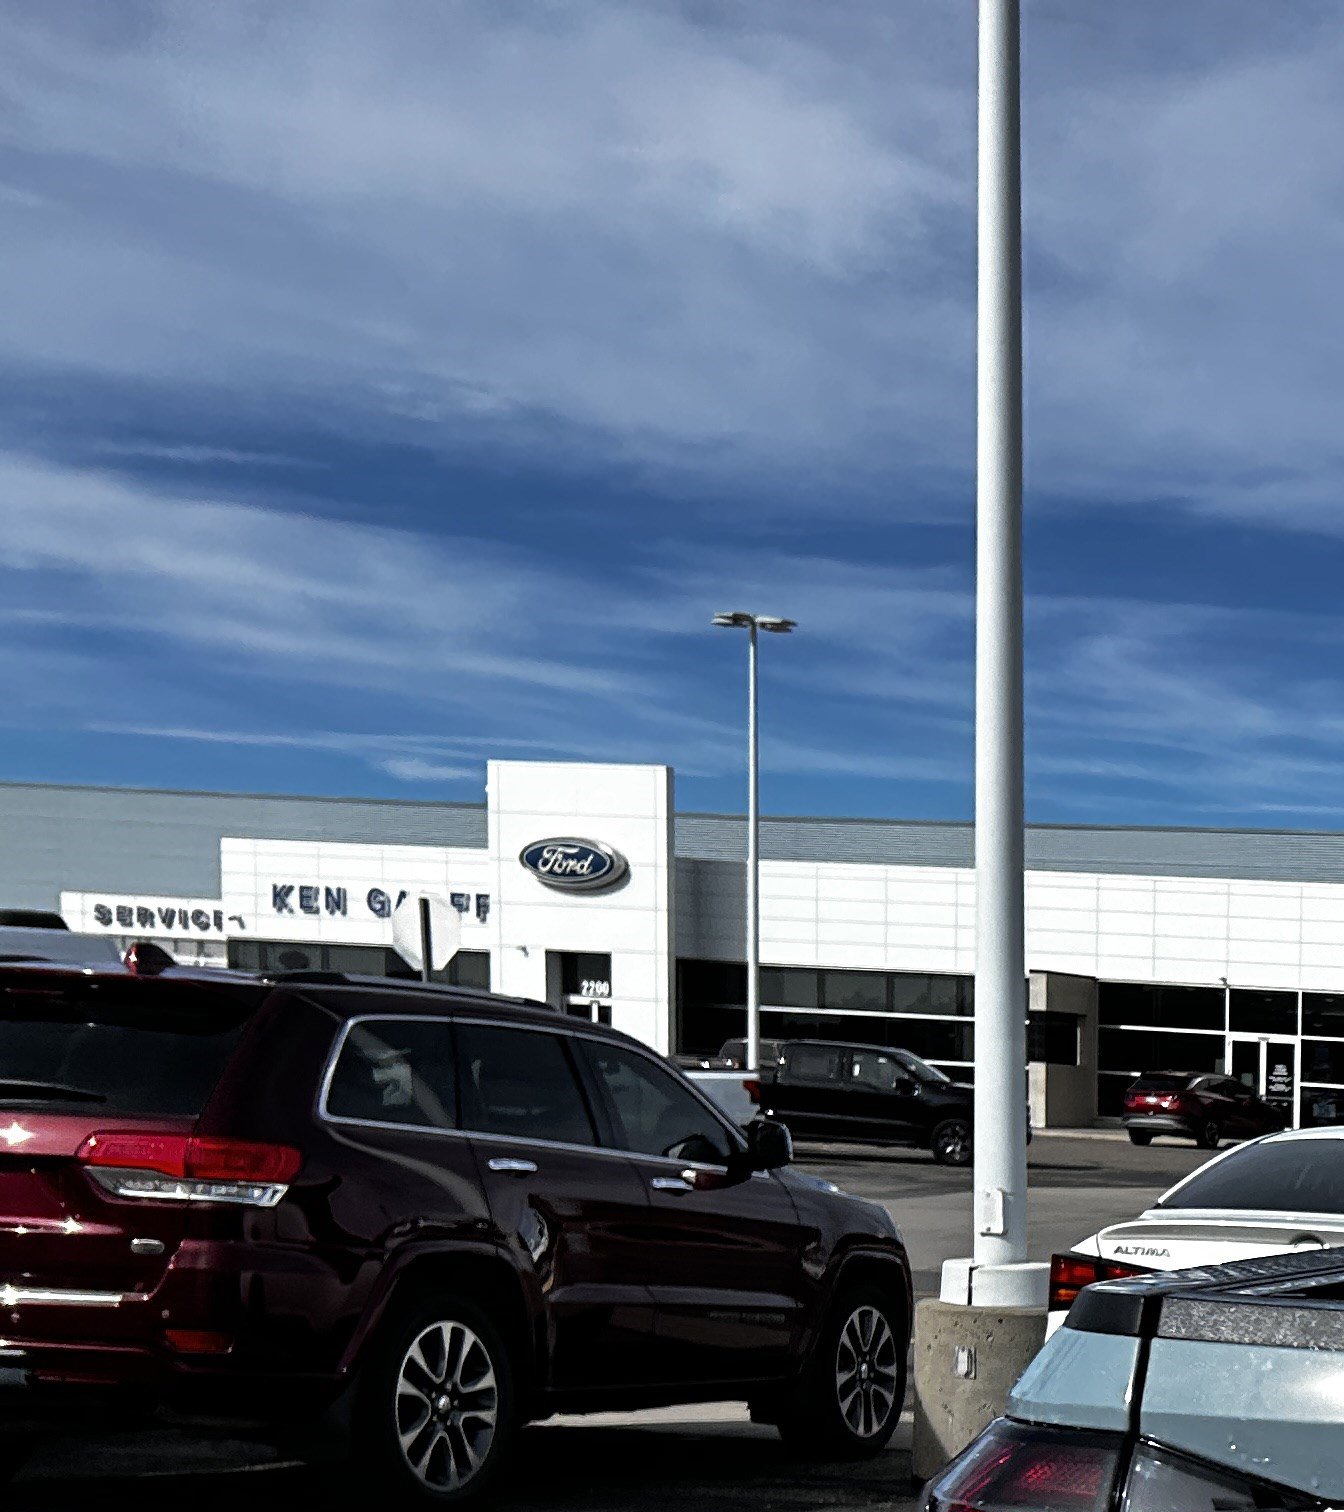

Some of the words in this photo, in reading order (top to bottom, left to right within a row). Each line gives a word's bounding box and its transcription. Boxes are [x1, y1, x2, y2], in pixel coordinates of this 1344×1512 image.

[538, 846, 592, 876] Ford
[272, 883, 347, 916] KEN
[366, 887, 491, 924] GFF
[1113, 1245, 1171, 1257] ALTIMA
